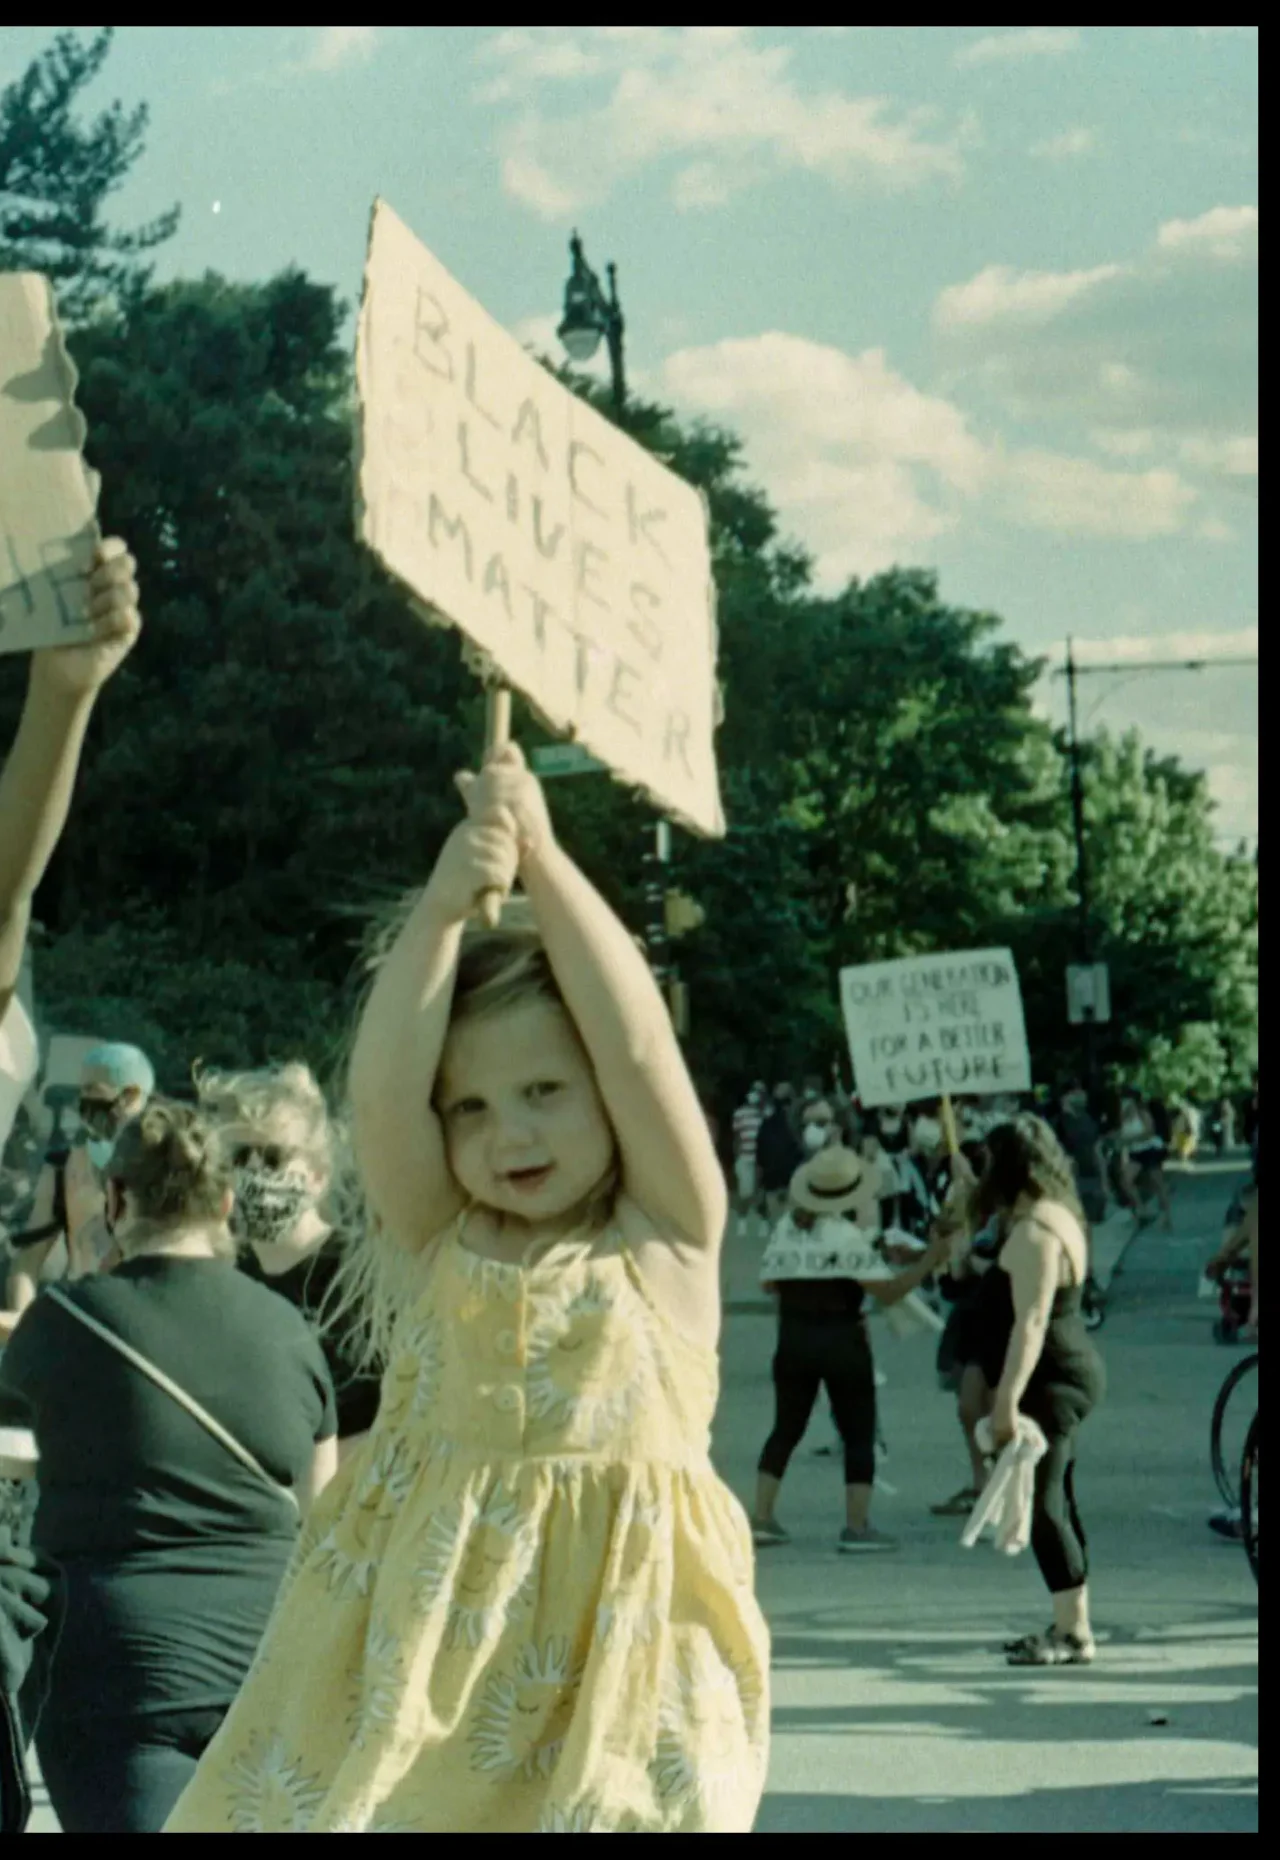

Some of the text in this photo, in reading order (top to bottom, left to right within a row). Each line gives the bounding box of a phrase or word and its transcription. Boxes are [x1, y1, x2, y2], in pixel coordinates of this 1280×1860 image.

[413, 285, 675, 573] BLACK
[457, 421, 663, 665] LIVES
[427, 492, 694, 780] MATTER
[884, 1055, 1006, 1091] FUTURE
[918, 1032, 933, 1053] A
